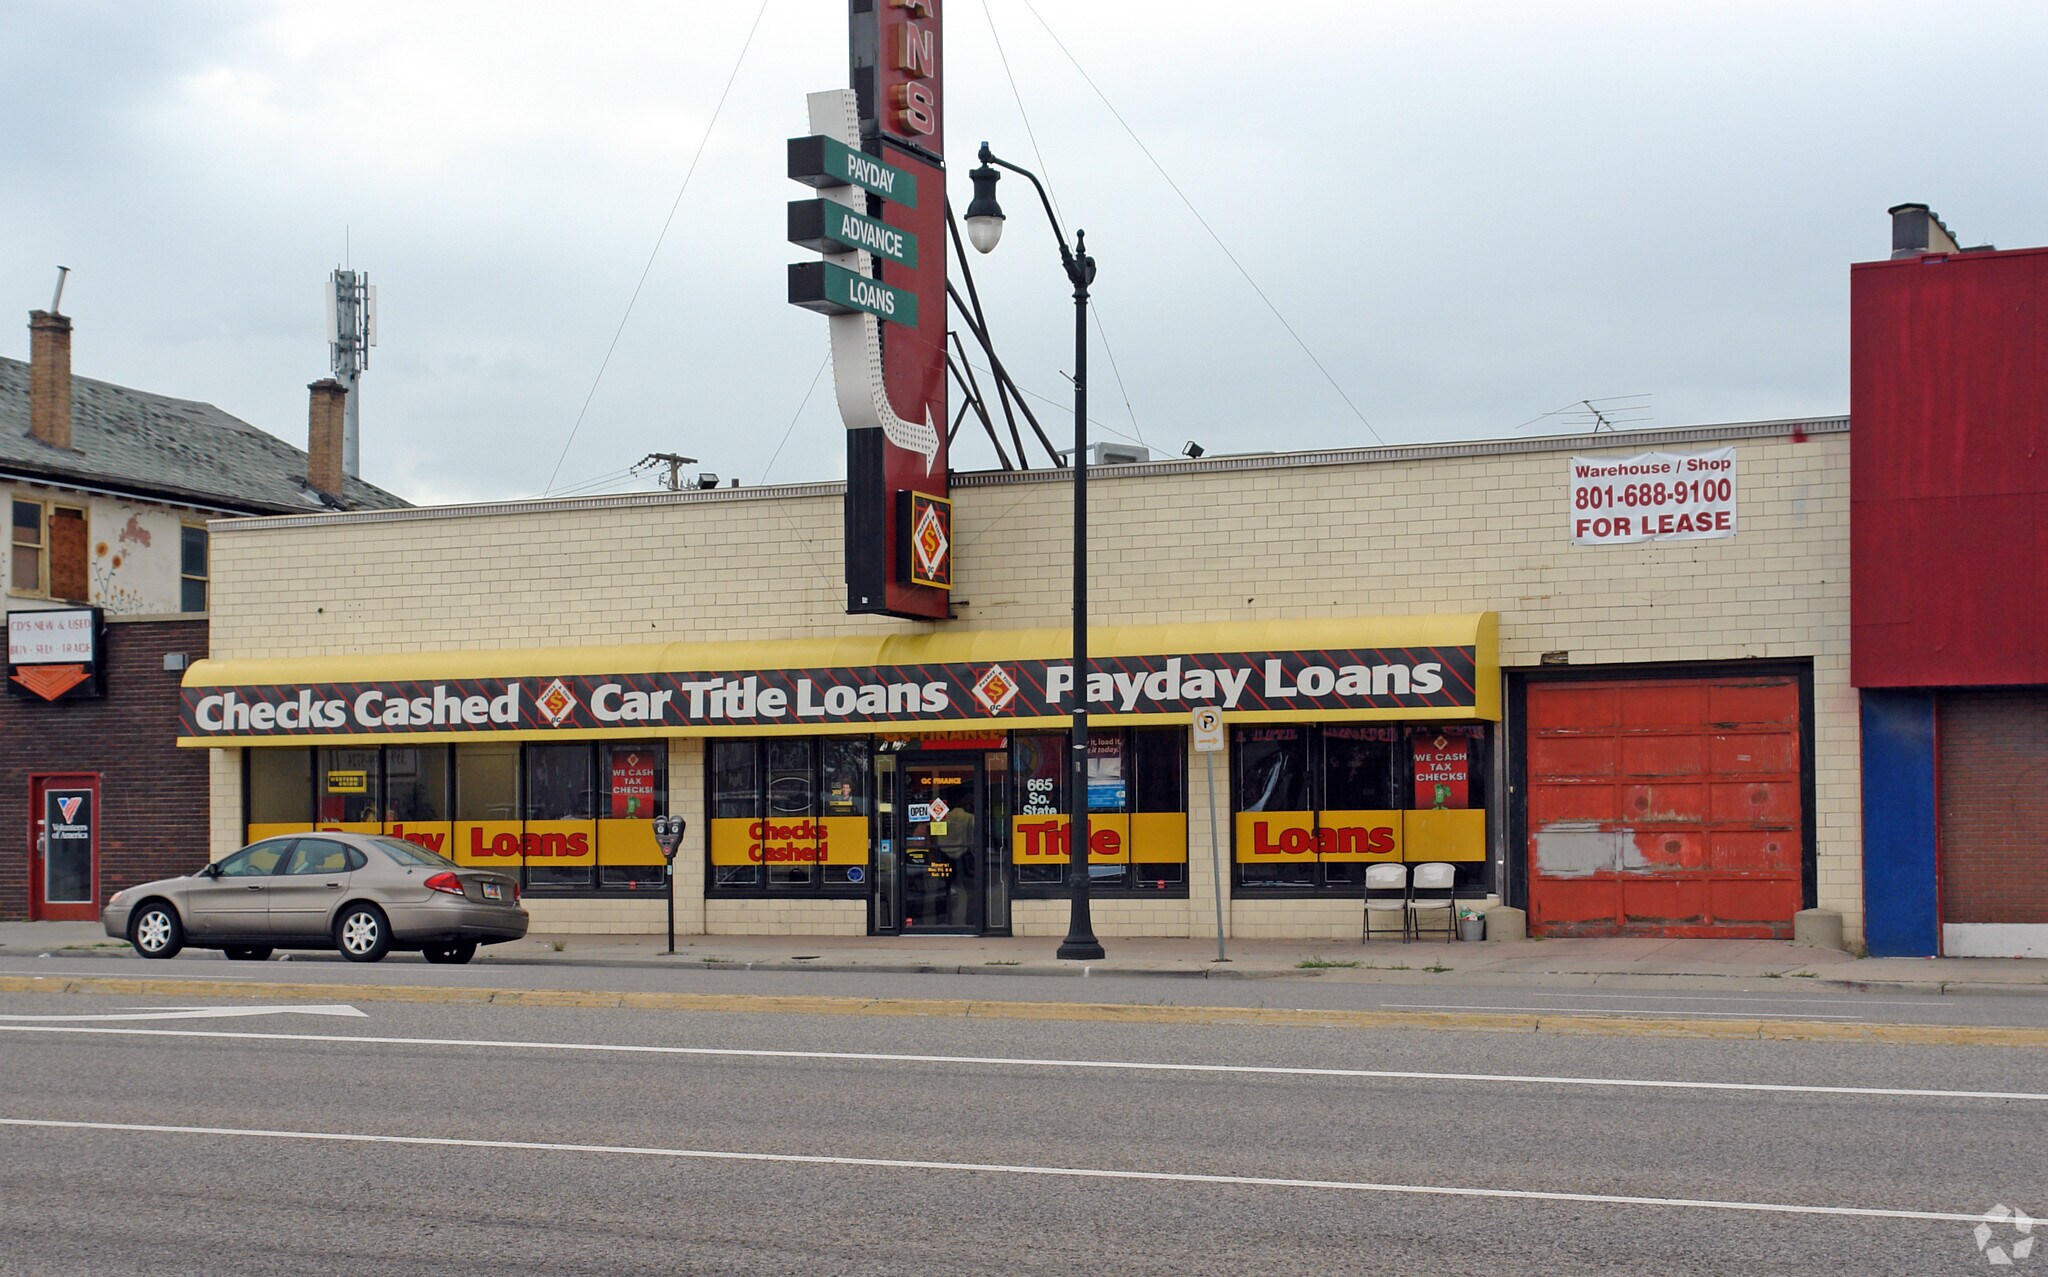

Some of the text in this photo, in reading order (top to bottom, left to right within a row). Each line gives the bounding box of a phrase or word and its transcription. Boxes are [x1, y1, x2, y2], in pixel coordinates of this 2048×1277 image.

[847, 153, 895, 193] PAYDAY
[841, 214, 903, 258] ADVANCE
[850, 278, 895, 315] LOANS
[1575, 458, 1731, 478] Warehouse / Shop
[1575, 478, 1731, 510] 801-688-9100
[1576, 511, 1731, 538] FOR LEASE
[34, 620, 53, 631] NEW
[68, 619, 91, 630] USED
[1045, 657, 1443, 711] Payday Loans
[195, 682, 520, 731] Checks Cashed
[590, 676, 948, 722] Car Title Loans
[1415, 752, 1467, 761] WE CASH
[1430, 763, 1452, 771] TAX
[1027, 778, 1053, 791] 665
[1416, 772, 1466, 781] CHECKS!
[613, 786, 653, 794] CHECKS!
[1029, 792, 1050, 805] So.
[911, 806, 928, 816] OPEN
[1023, 805, 1057, 815] State
[749, 820, 828, 840] Checks
[1017, 819, 1121, 855] Tite
[1254, 821, 1395, 855] Loans
[471, 827, 589, 857] Loans
[748, 841, 828, 862] Cashed
